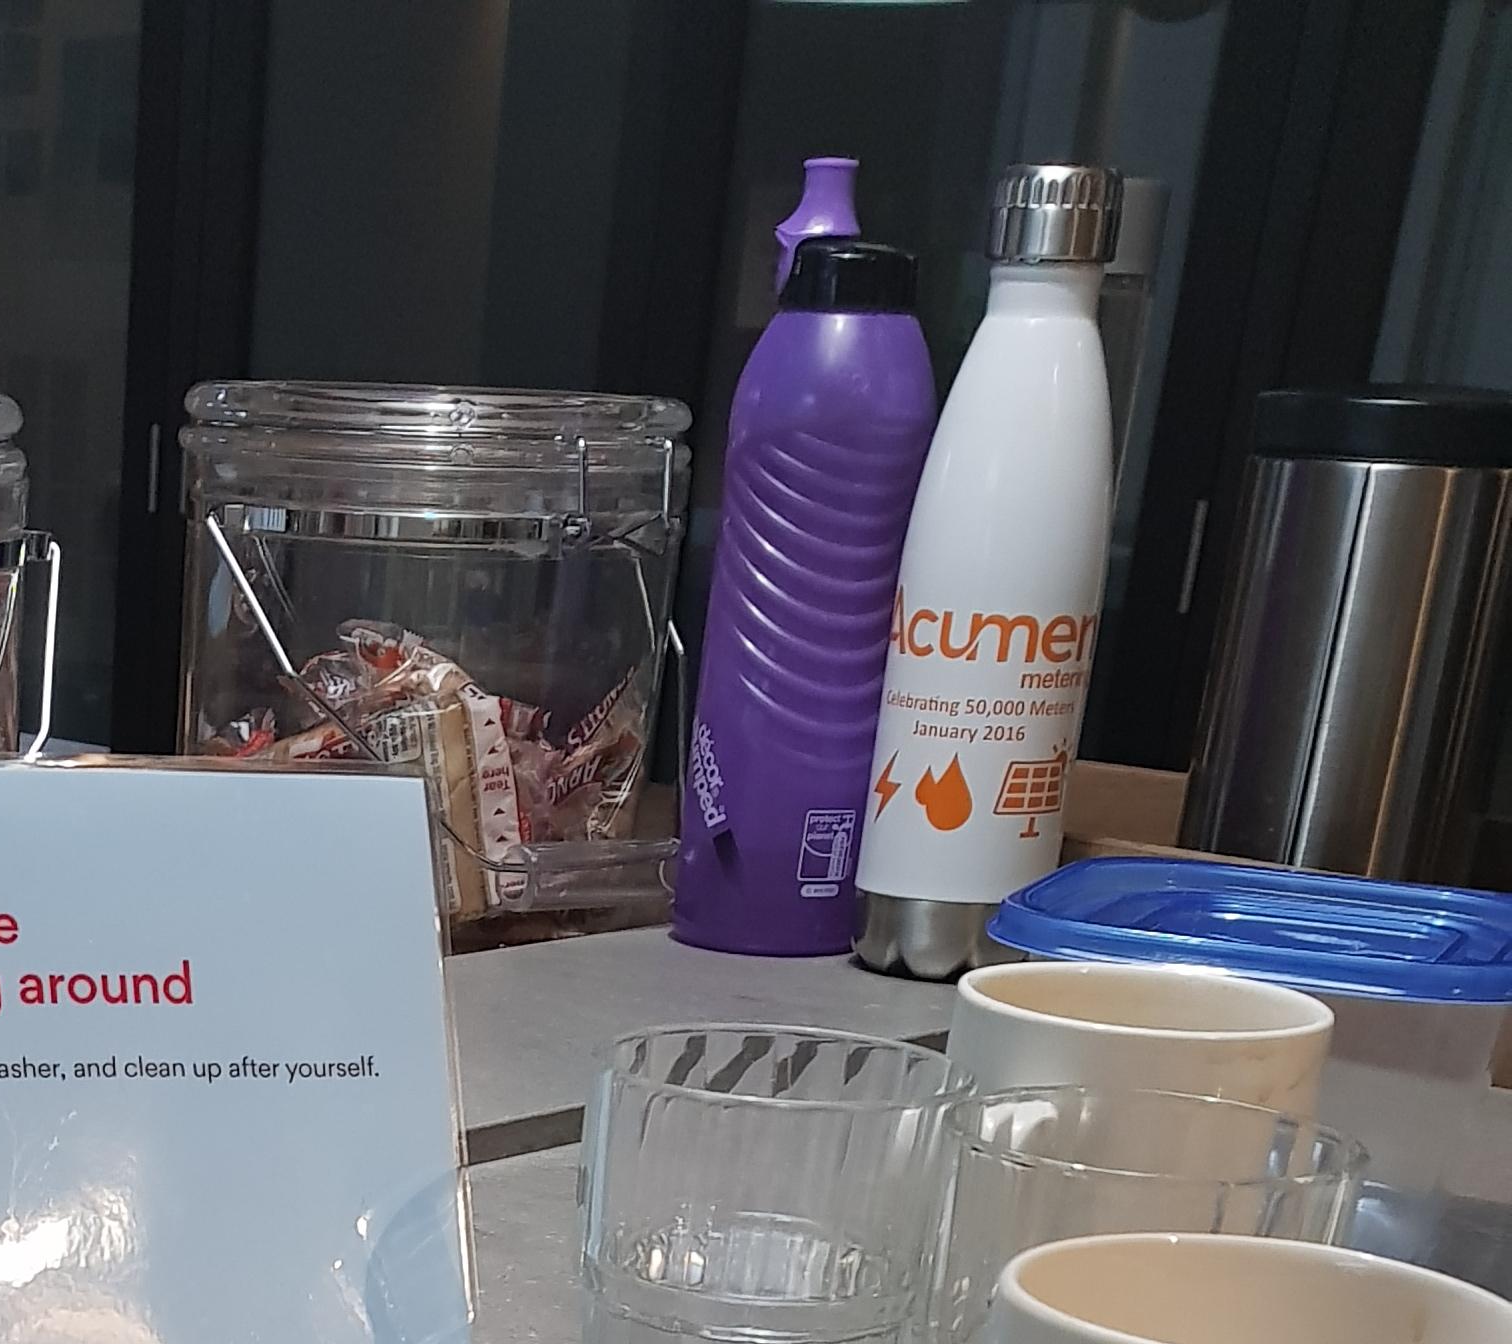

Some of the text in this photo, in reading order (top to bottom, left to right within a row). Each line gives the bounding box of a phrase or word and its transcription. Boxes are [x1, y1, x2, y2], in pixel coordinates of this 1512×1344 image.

[886, 689, 960, 717] Celebrating
[964, 697, 1025, 719] 50,000
[912, 720, 1026, 744] January 2016
[20, 960, 193, 1005] around
[73, 1055, 117, 1079] and
[124, 1055, 186, 1078] clean
[192, 1062, 222, 1084] up
[228, 1055, 280, 1079] after
[284, 1055, 380, 1084] yourself.
